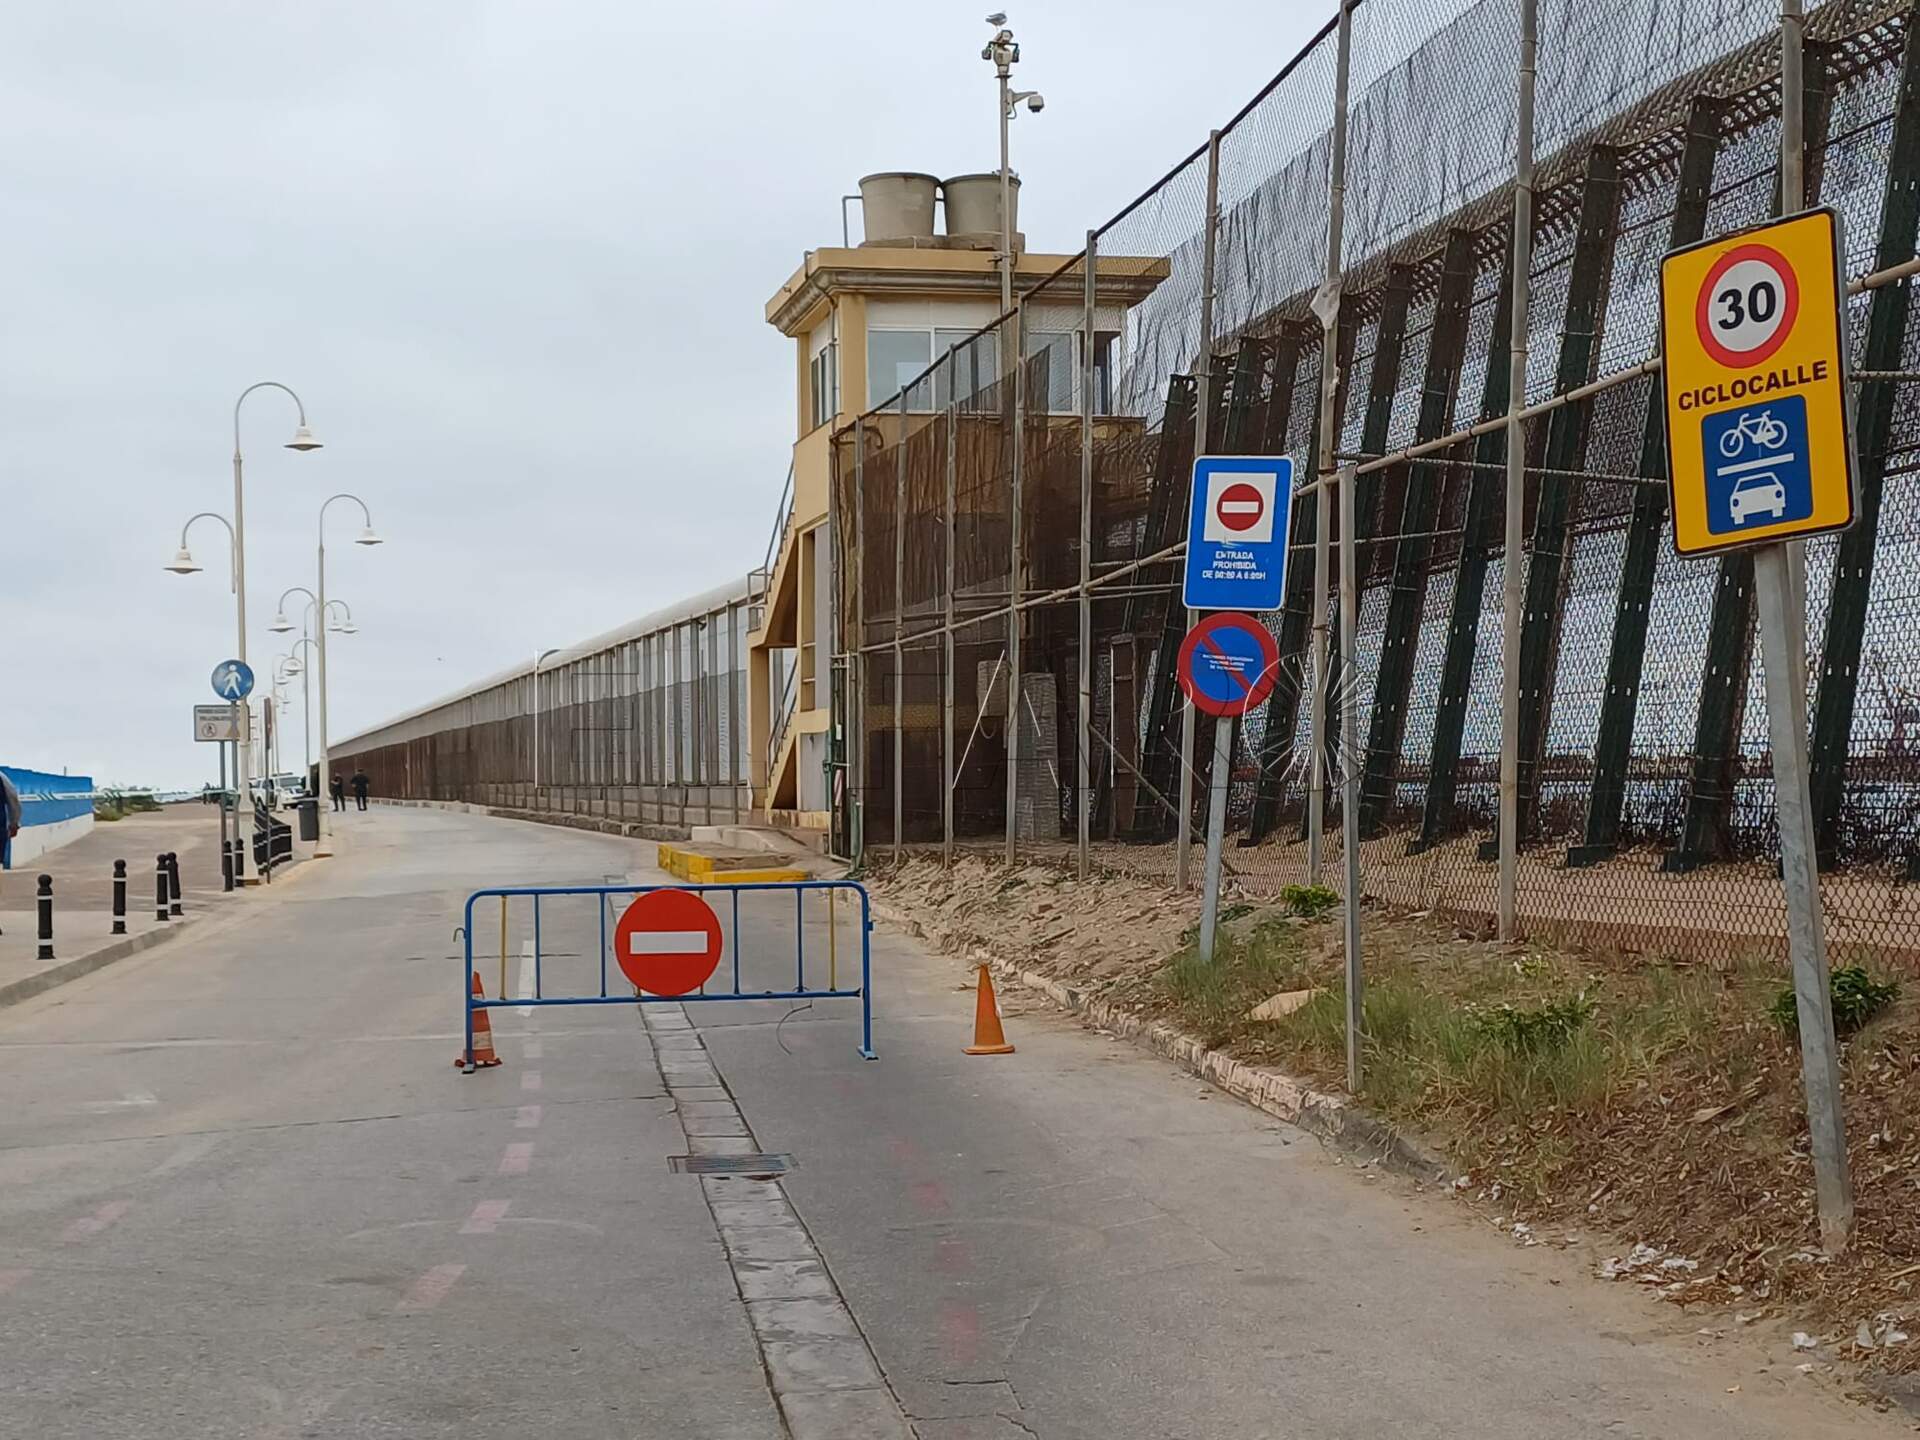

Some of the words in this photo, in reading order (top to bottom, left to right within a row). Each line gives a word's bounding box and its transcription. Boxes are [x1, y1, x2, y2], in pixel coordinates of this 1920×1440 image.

[1717, 281, 1777, 330] 30
[1678, 360, 1828, 410] CICLOCALLE
[1215, 550, 1254, 560] ENTRADA
[1212, 560, 1257, 570] PROHIBIDA
[1202, 570, 1214, 579] DE
[1236, 571, 1243, 580] A
